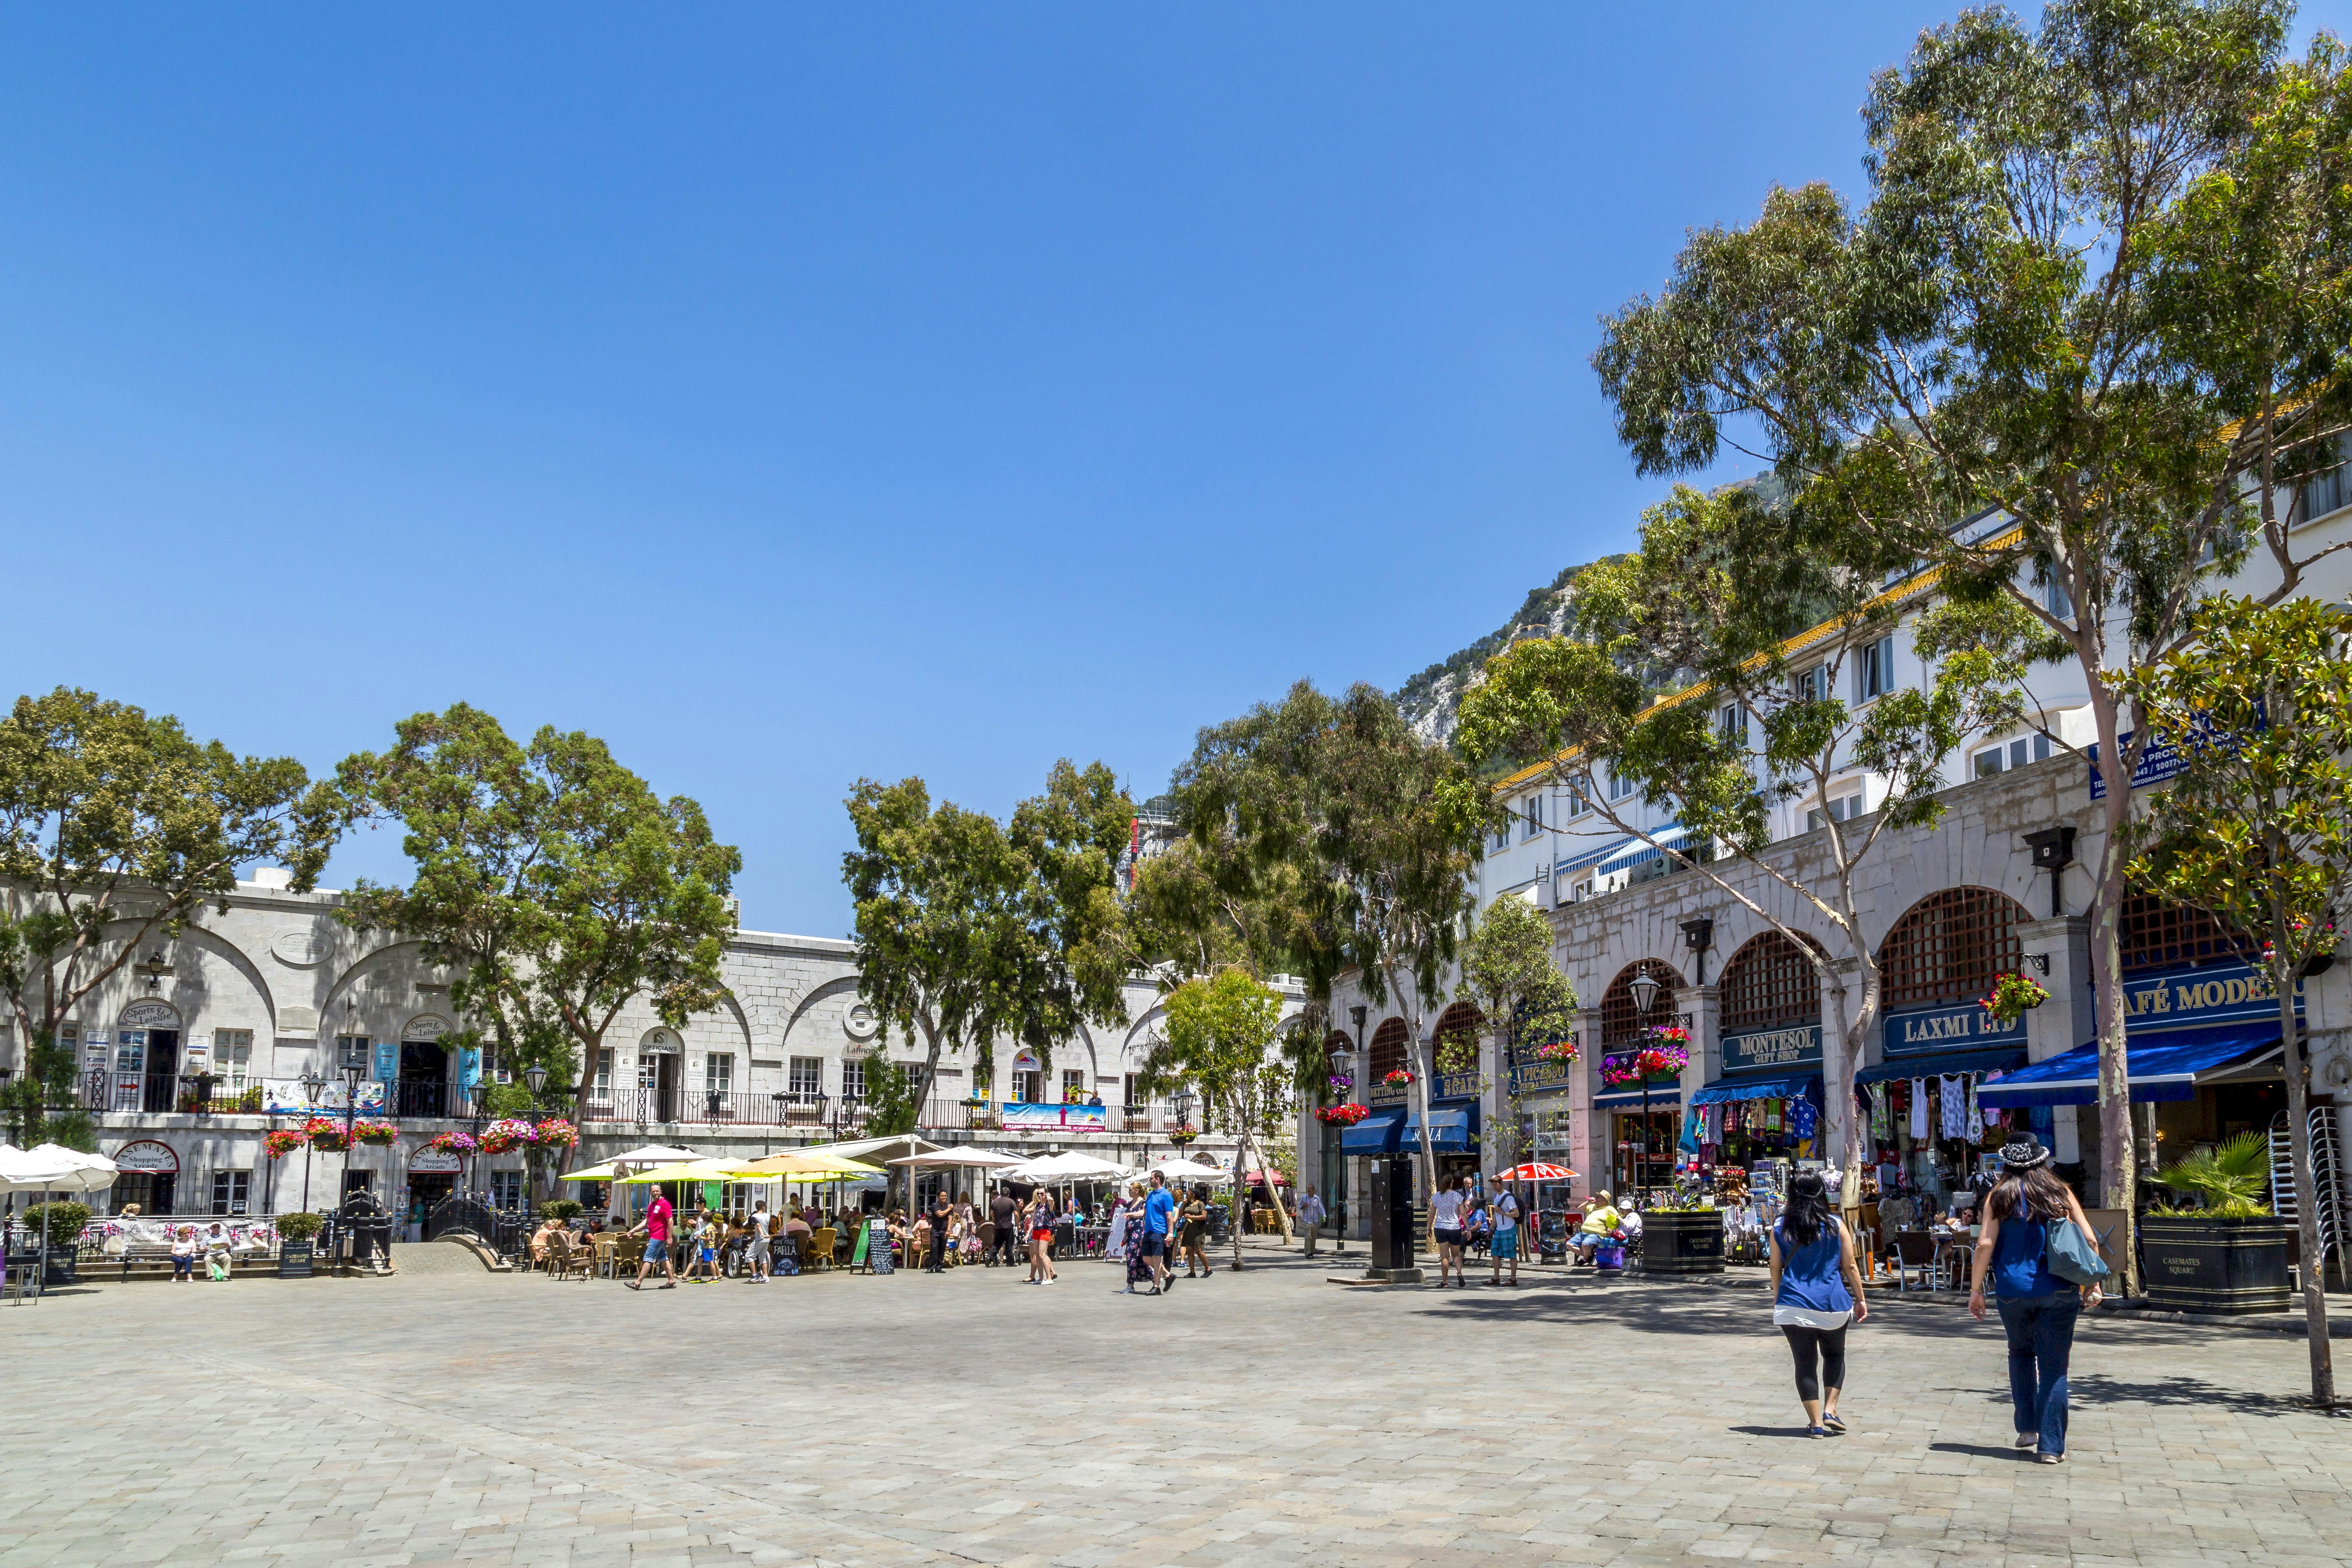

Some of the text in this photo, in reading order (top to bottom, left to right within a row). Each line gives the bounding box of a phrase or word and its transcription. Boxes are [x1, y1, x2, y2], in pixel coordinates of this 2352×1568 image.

[2133, 767, 2148, 777] 643
[2124, 979, 2170, 1016] AFÉ
[127, 1007, 164, 1018] Sports &
[139, 1014, 171, 1025] Leisure
[410, 1021, 433, 1030] Sports
[1904, 1012, 2017, 1042] LAXMI LTD
[1739, 1029, 1815, 1056] MONTESOL
[1754, 1050, 1799, 1064] GIFT SHOP
[1523, 1064, 1565, 1082] PICASSO
[1412, 1127, 1441, 1141] SCLA
[116, 1143, 175, 1168] CASEMATES
[411, 1147, 459, 1169] CASETES
[128, 1224, 161, 1235] Larry's
[774, 1246, 797, 1255] PAELLA
[2169, 1266, 2195, 1274] SQUARE
